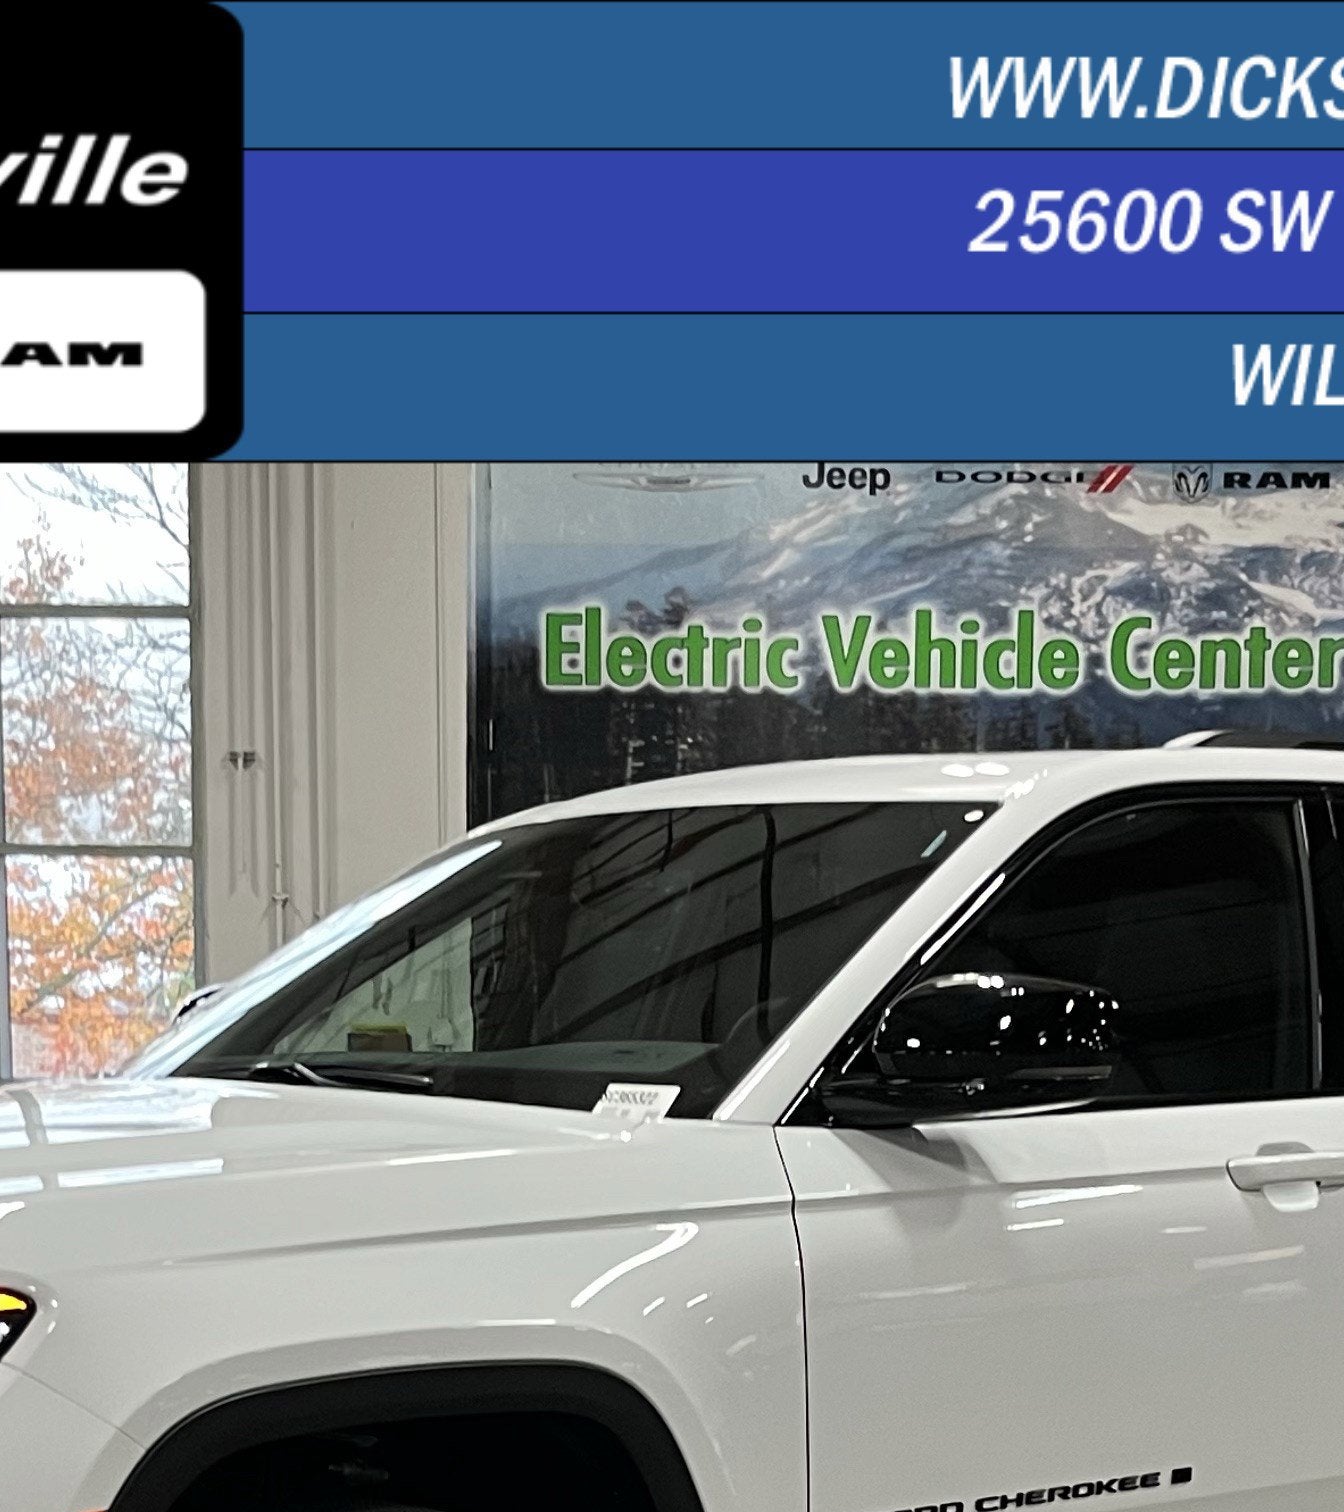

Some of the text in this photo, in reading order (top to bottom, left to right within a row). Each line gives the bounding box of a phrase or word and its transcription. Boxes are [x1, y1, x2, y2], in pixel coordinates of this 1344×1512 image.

[802, 462, 891, 496] Jeep
[1223, 471, 1332, 490] RAM
[545, 607, 799, 688] Electric
[821, 610, 1081, 691] Vehicle
